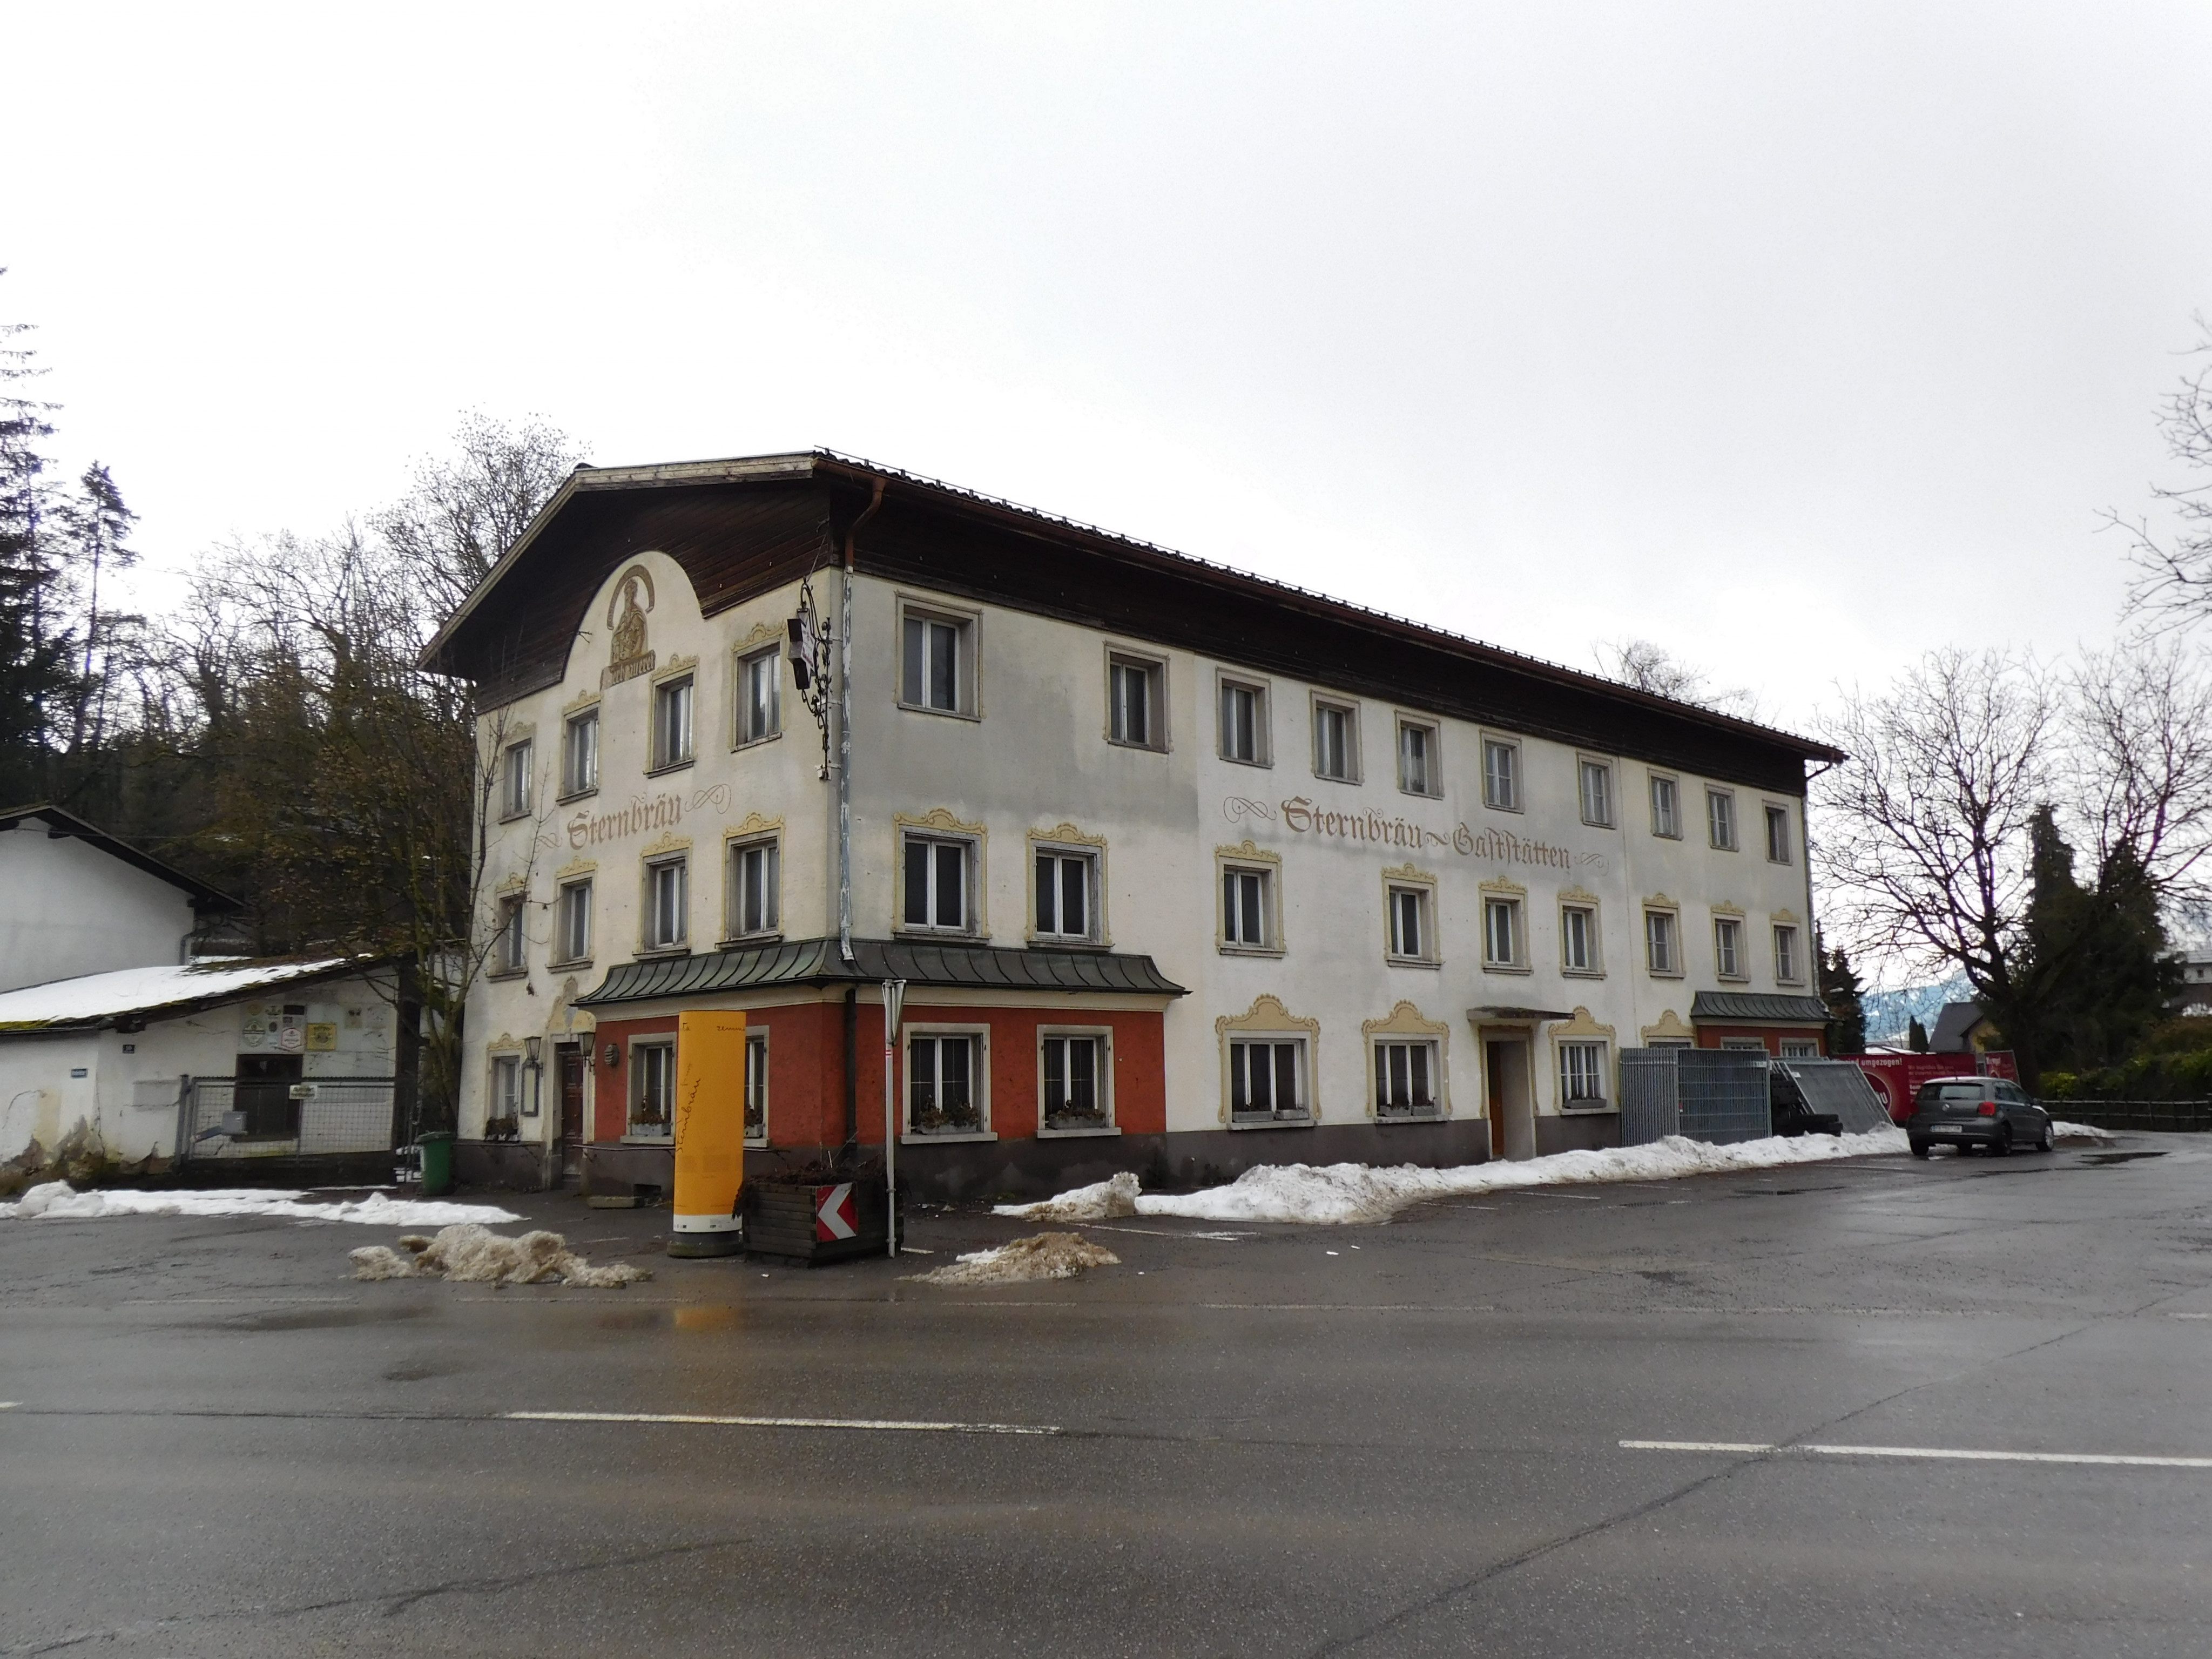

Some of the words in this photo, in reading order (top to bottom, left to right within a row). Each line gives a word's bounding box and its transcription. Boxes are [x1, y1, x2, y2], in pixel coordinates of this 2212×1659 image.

[568, 792, 682, 850] Sternbräu
[1280, 795, 1423, 849] Sternbräu
[1453, 821, 1570, 869] Gaststätten
[1861, 1057, 1903, 1068] umgezogen!
